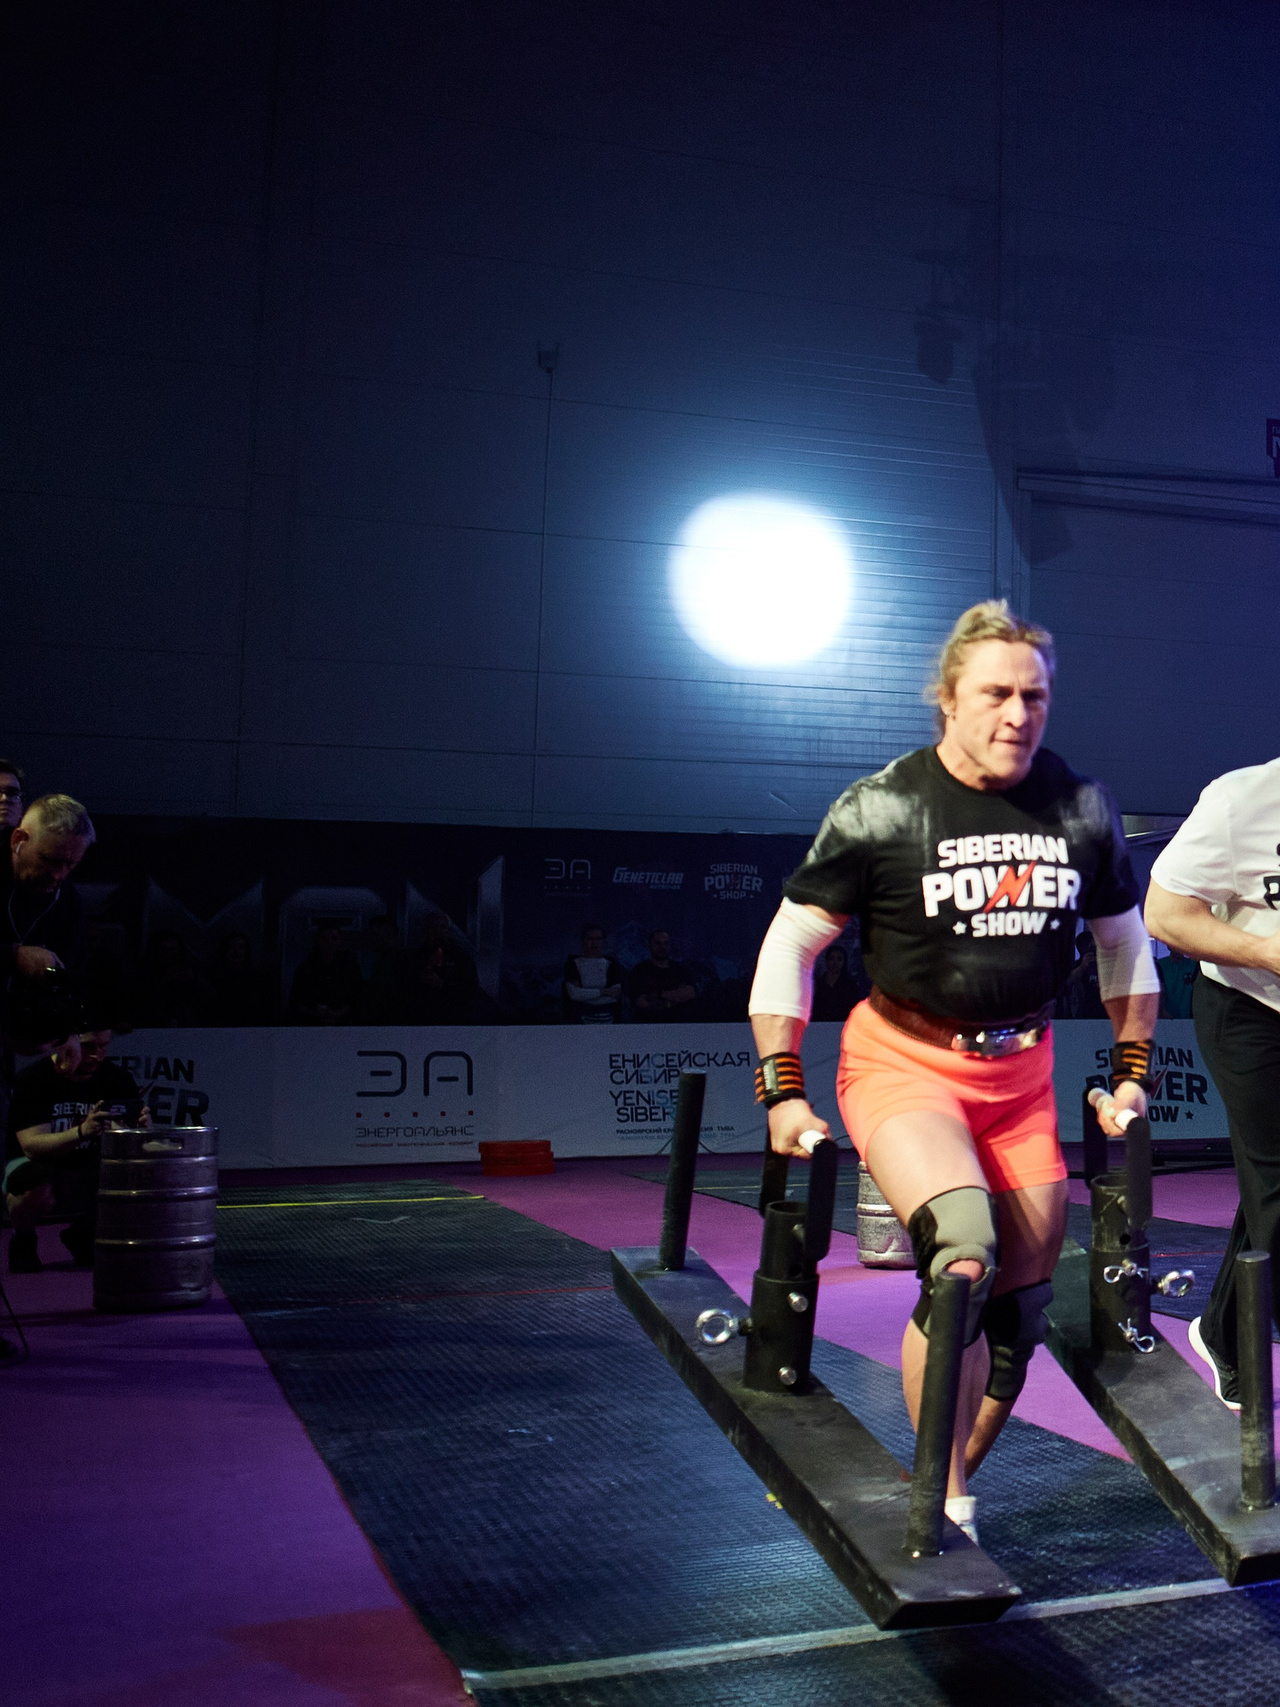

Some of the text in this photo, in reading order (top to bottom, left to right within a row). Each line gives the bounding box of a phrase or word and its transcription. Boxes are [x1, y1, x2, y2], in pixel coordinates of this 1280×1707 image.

[937, 833, 1069, 868] SIBERIAN
[709, 863, 758, 875] SIBERIAN
[704, 874, 763, 892] POWER
[922, 863, 1082, 917] POWER
[719, 890, 747, 900] SHOP
[970, 911, 1048, 938] SHOW
[609, 1050, 750, 1069] ЕНИСЕЙСКАЯ
[610, 1069, 680, 1085] СИБИР
[609, 1090, 679, 1106] YENISE
[52, 1102, 96, 1116] SIBERI
[616, 1106, 677, 1123] SIBER
[1146, 1106, 1179, 1122] OW
[356, 1125, 474, 1138] ЭНЕРГОАЛЬЯНС
